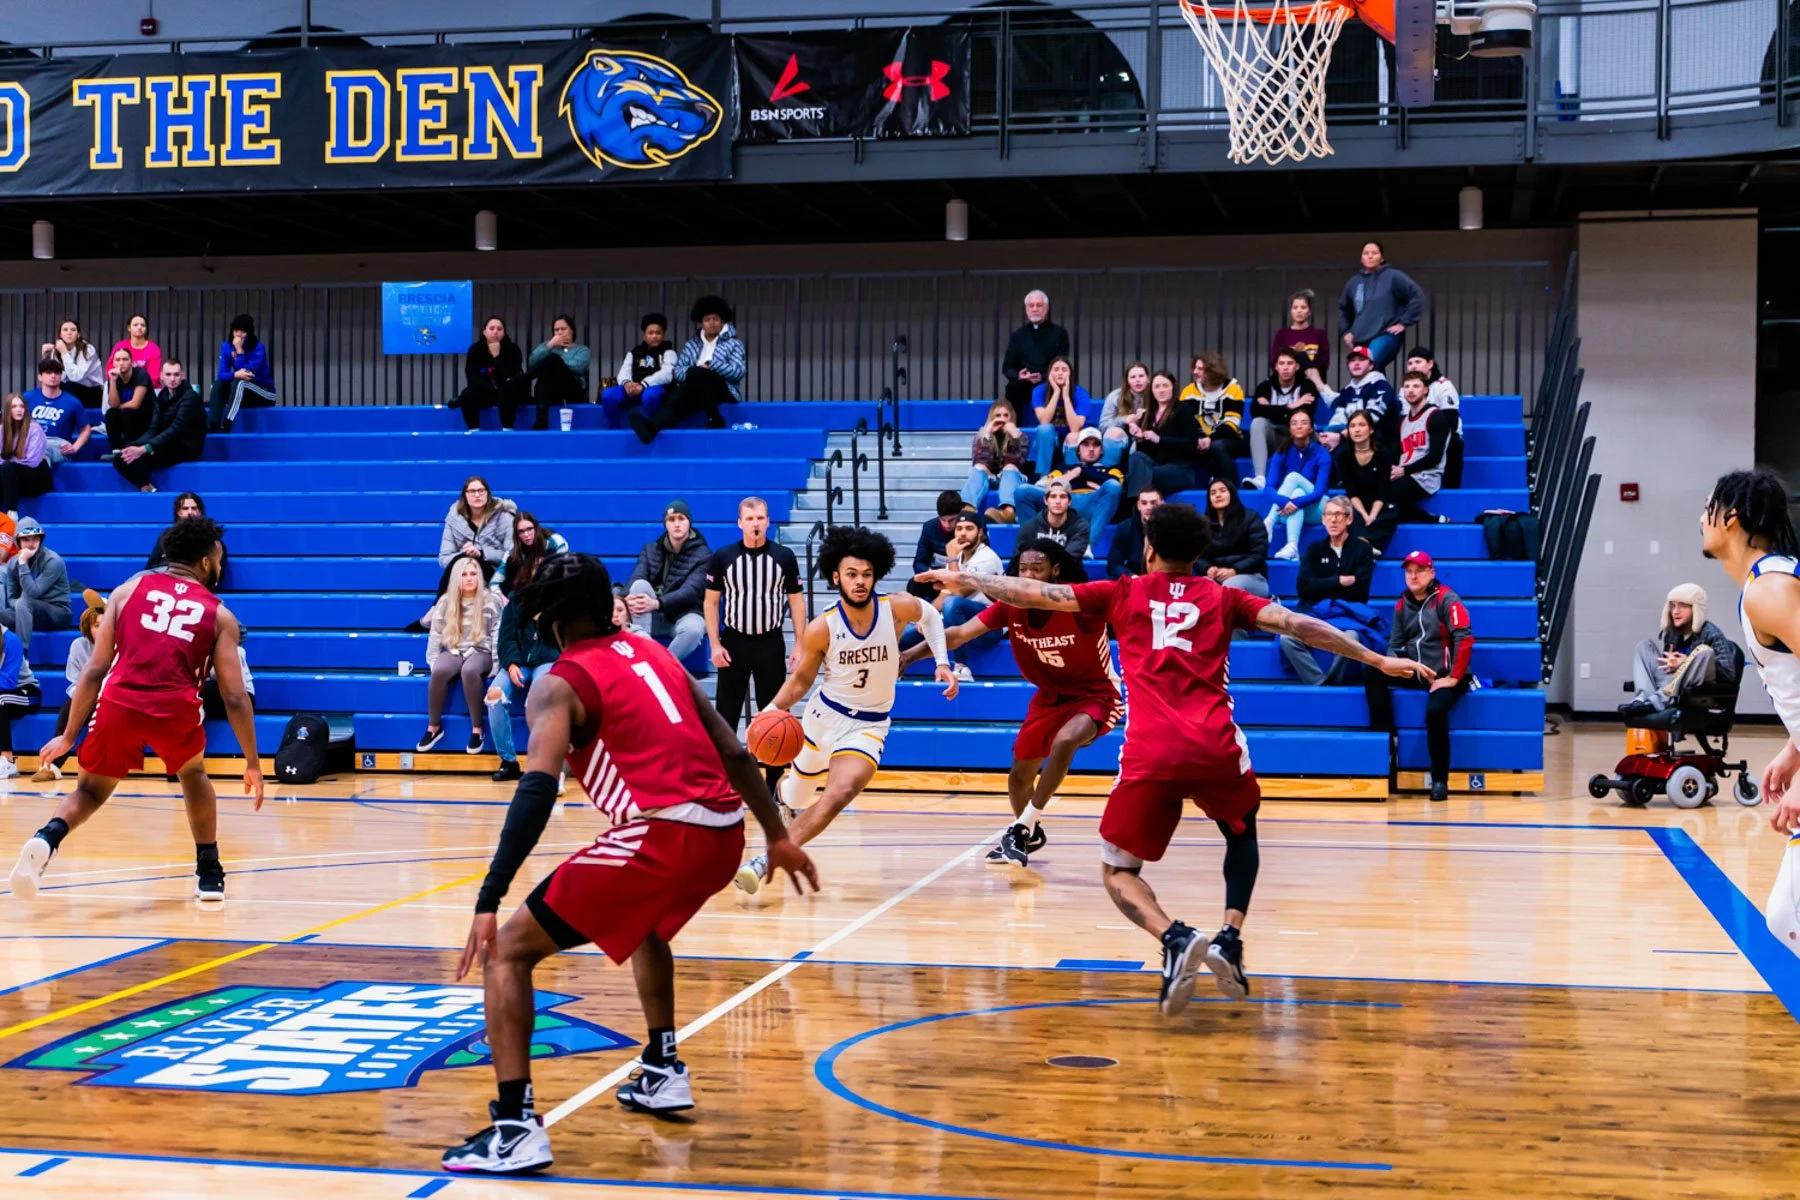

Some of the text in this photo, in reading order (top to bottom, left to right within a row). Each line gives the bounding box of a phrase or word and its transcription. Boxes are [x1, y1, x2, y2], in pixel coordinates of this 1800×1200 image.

[72, 72, 282, 170] THE
[325, 64, 544, 164] DEN
[31, 405, 64, 421] CUBS
[140, 590, 205, 642] 32
[1149, 600, 1200, 652] 12
[839, 645, 888, 664] BRESCIA
[853, 669, 869, 689] 3
[631, 661, 683, 724] 1
[121, 998, 324, 1060] RIVER
[134, 985, 485, 1090] STATES
